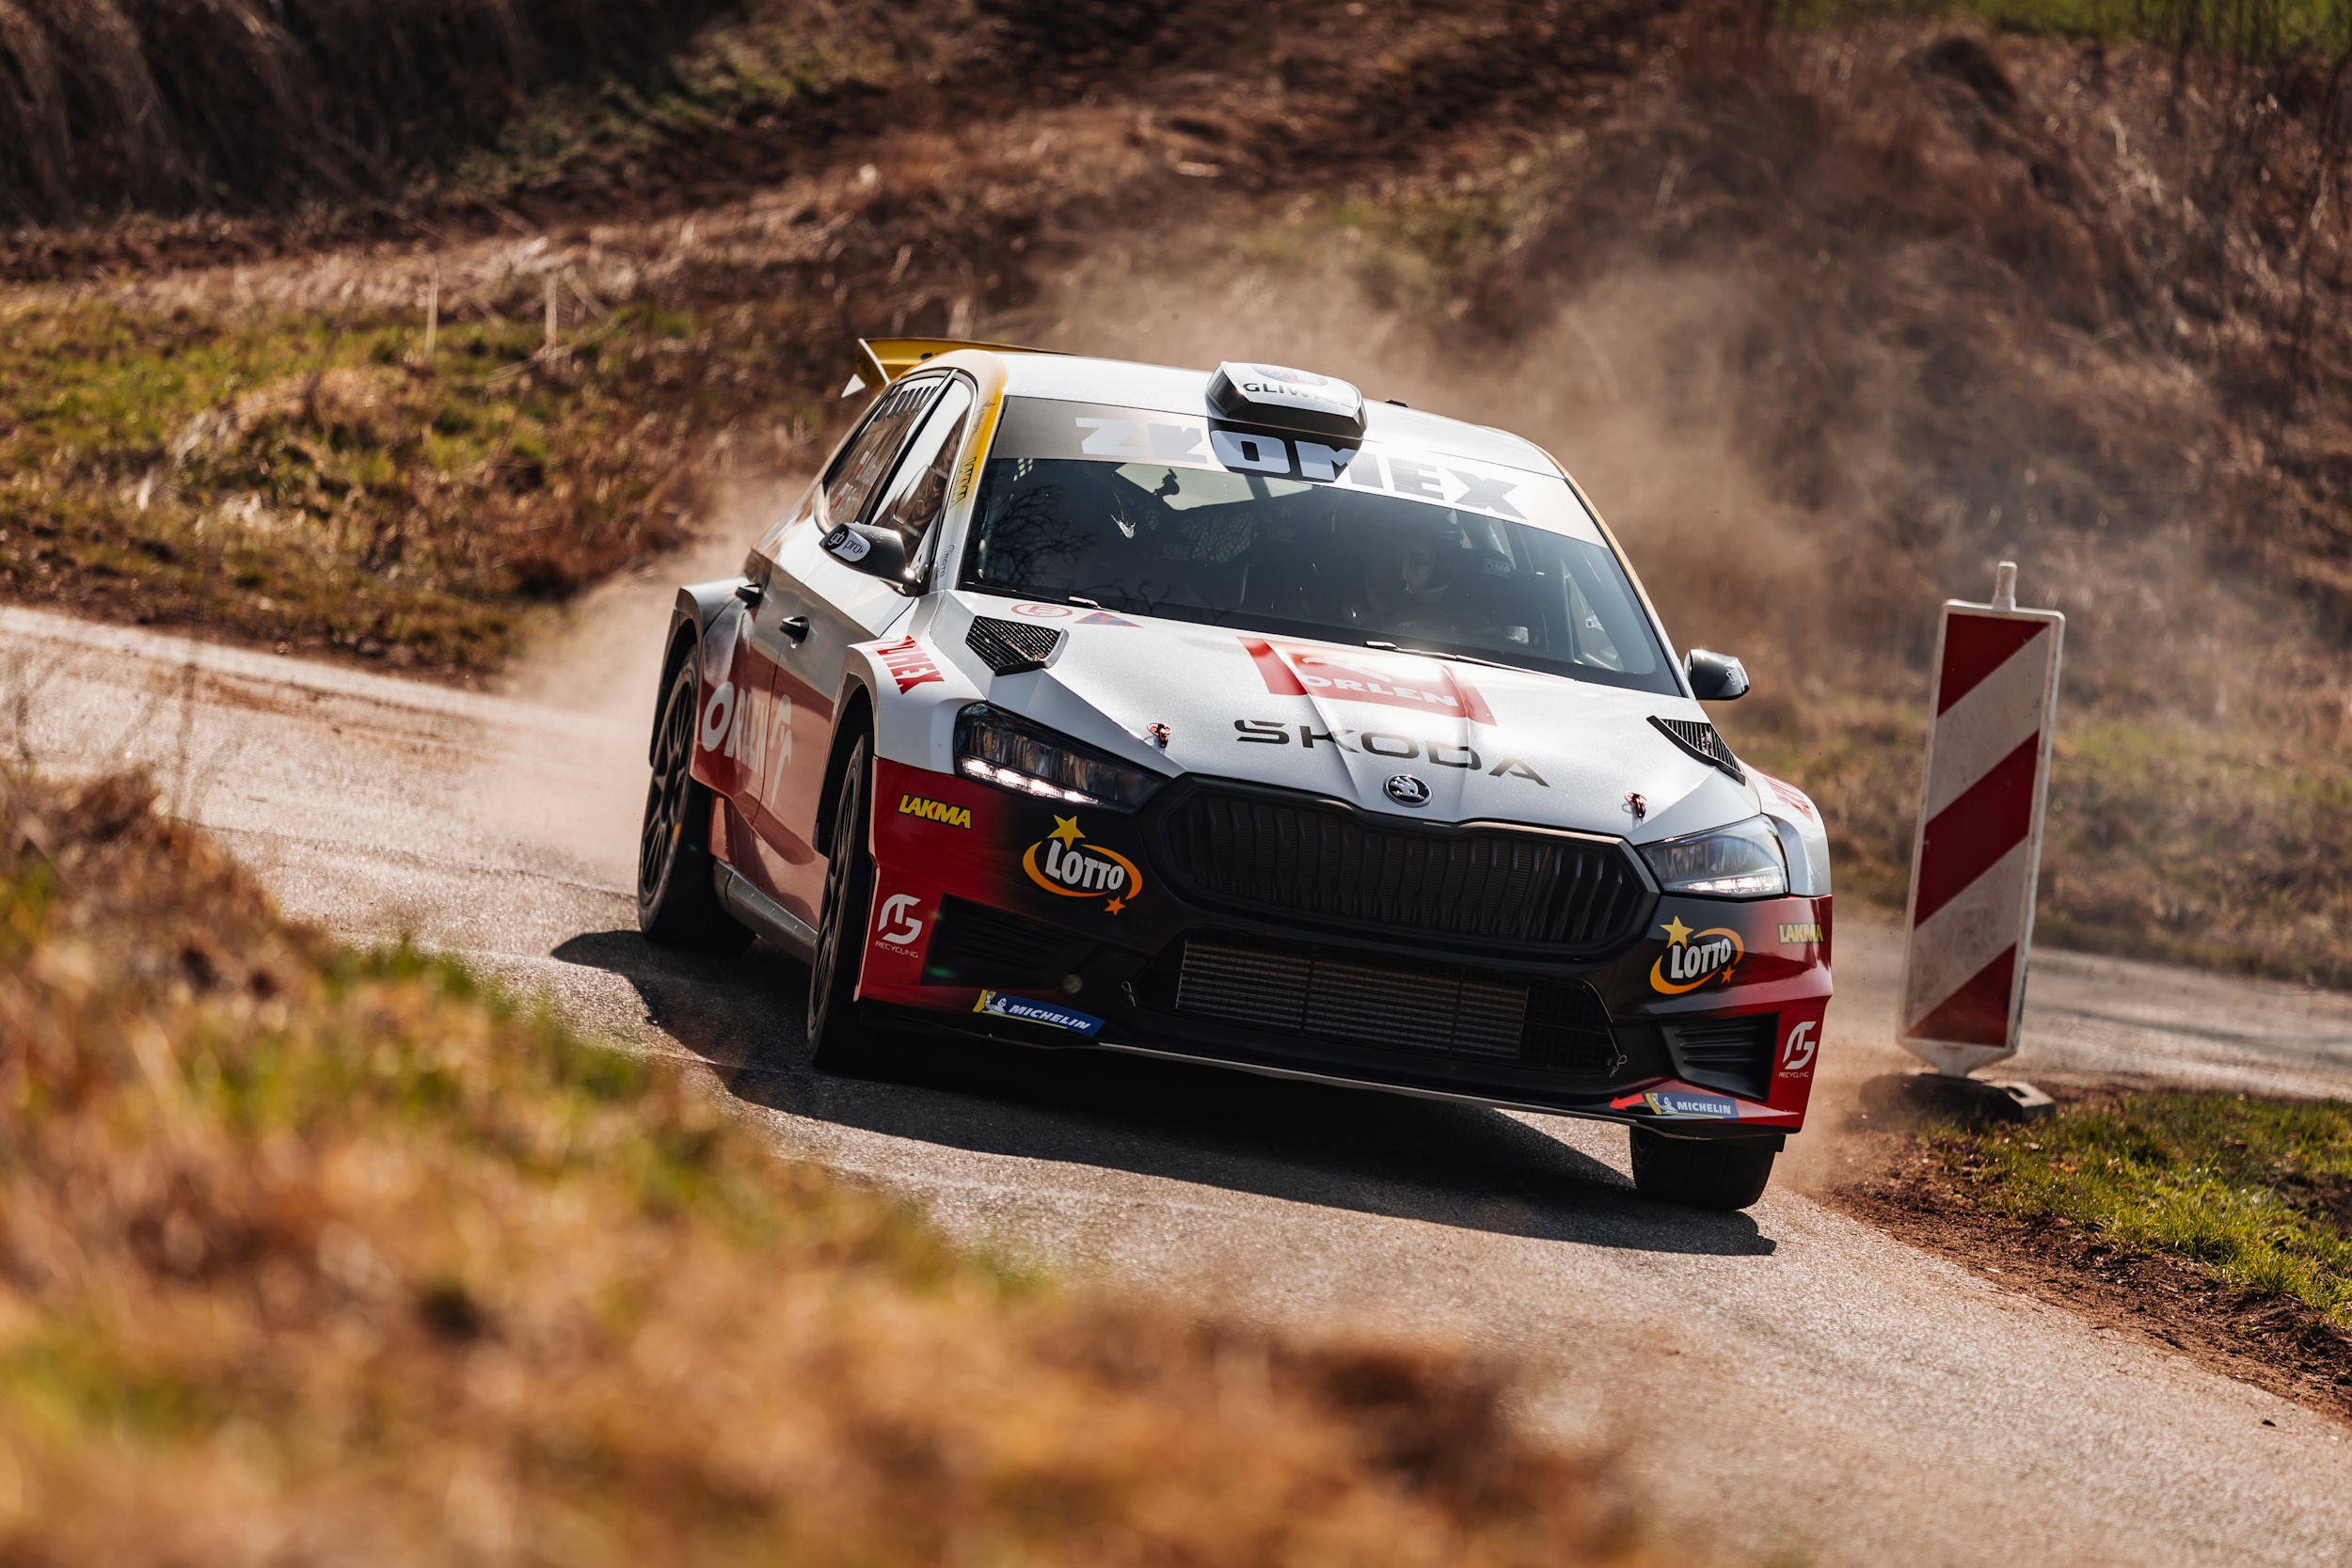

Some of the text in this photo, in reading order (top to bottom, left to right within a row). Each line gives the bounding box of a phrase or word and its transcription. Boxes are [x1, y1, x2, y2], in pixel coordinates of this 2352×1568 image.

[827, 531, 861, 553] gb pro
[1164, 546, 1190, 557] OMP
[1485, 562, 1511, 576] OMP
[866, 635, 945, 695] OMEX
[1300, 674, 1458, 707] ORLEN
[701, 681, 770, 778] ORLEN
[898, 794, 971, 830] LAKMA
[1044, 839, 1125, 891] LOTTO
[1778, 923, 1824, 943] LAKMA
[875, 941, 919, 958] RECYCLING
[1670, 938, 1732, 979] LOTTO
[1008, 1005, 1091, 1030] MICHELIN
[1677, 1101, 1732, 1115] MICHELIN
